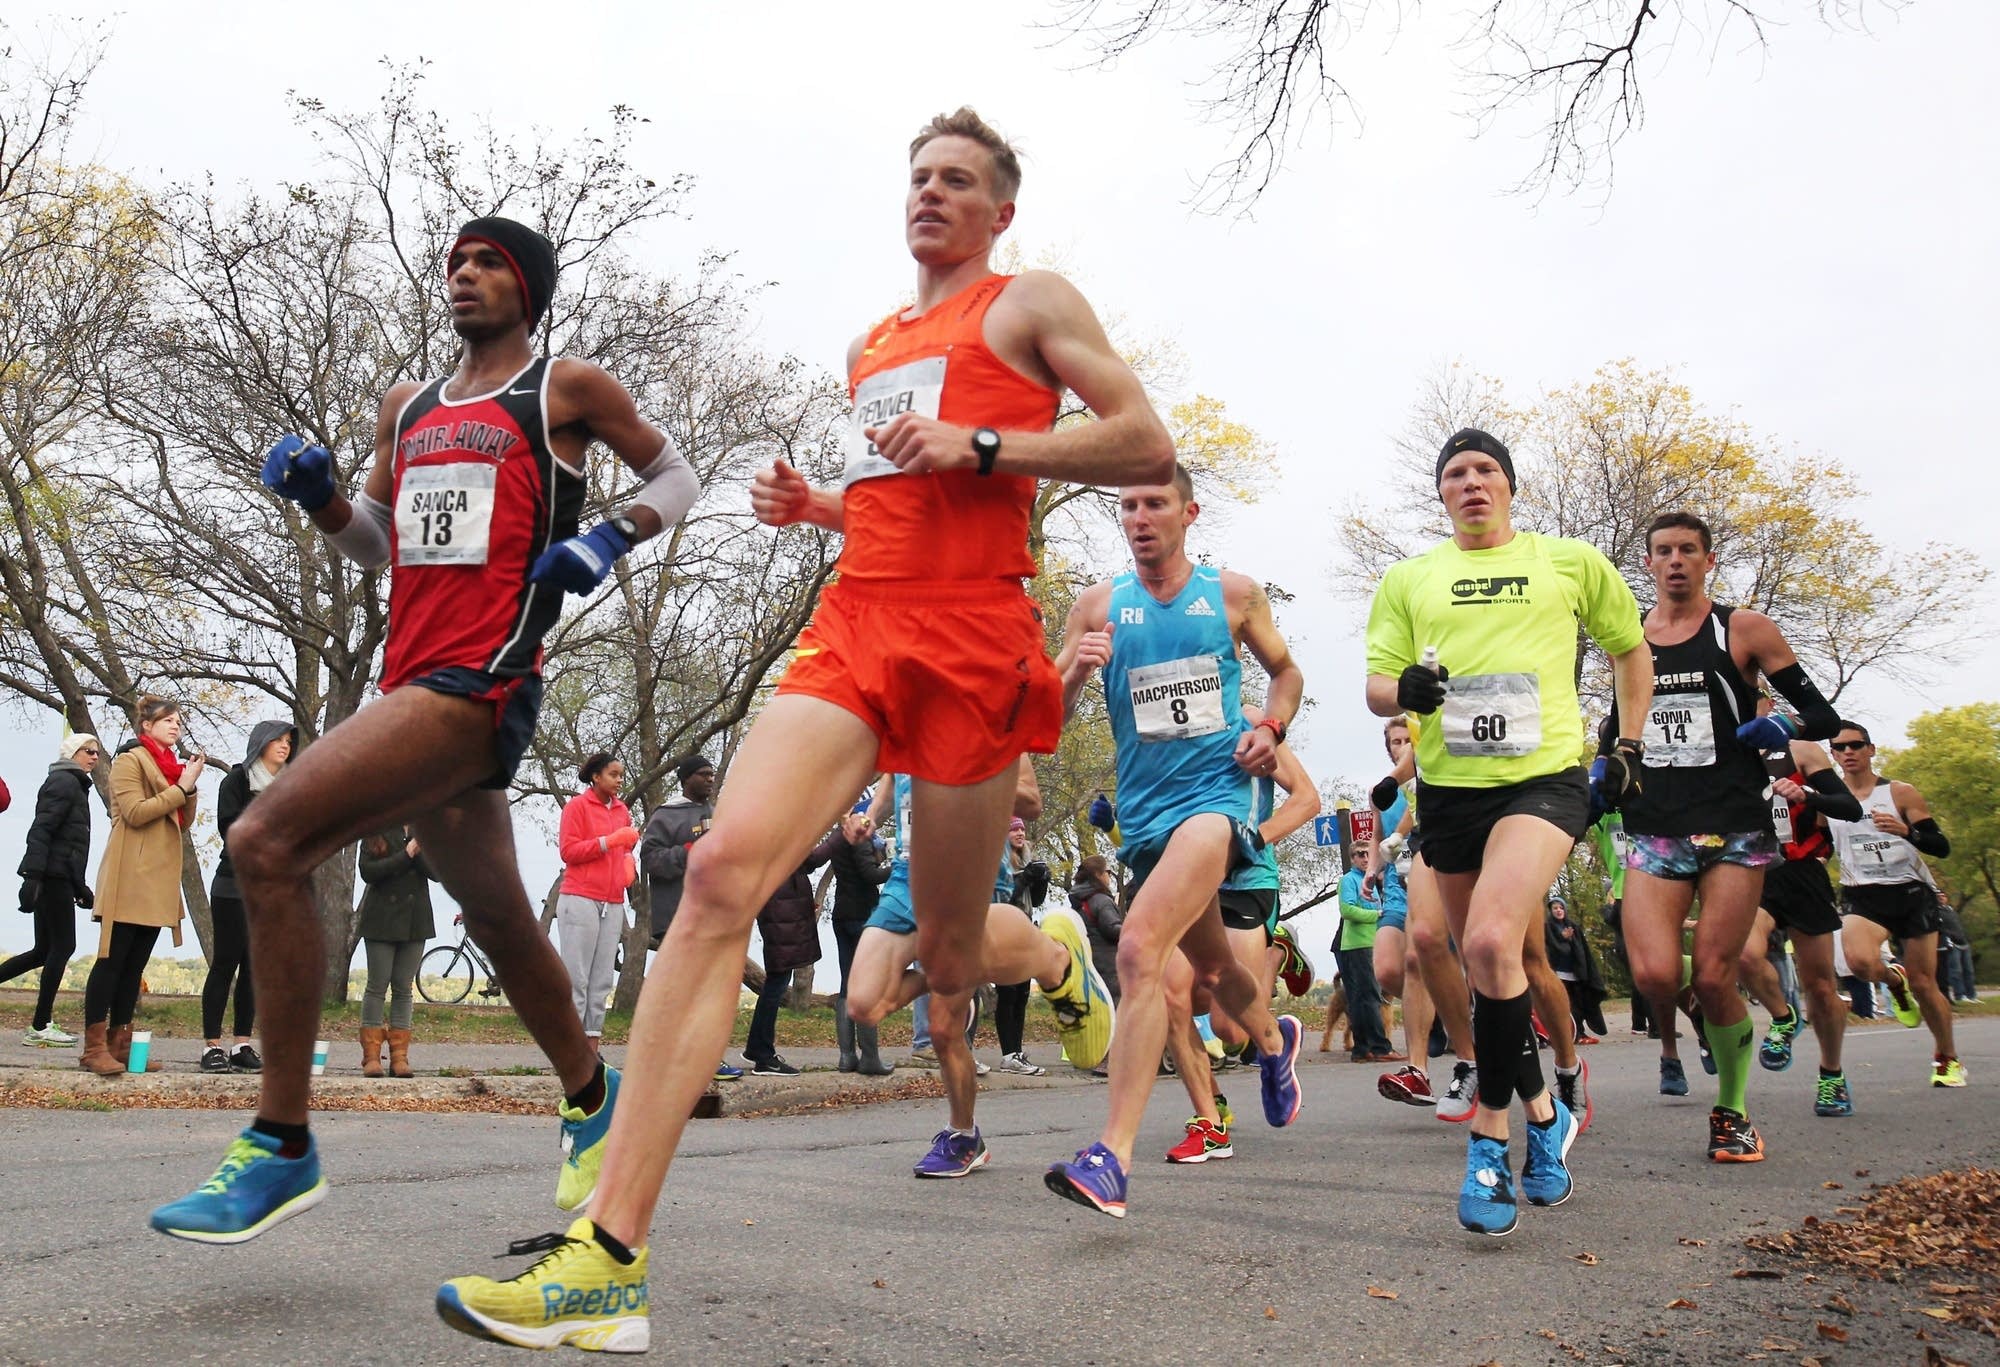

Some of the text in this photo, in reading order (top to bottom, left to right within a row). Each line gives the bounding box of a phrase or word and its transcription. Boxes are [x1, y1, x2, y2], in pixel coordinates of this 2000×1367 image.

[400, 420, 520, 463] WHIRLAWAY
[411, 490, 468, 513] SANCA
[421, 512, 453, 546] 13
[1452, 583, 1489, 592] INSIDE
[1184, 608, 1216, 617] adidas
[1132, 676, 1220, 706] MACPHERSON
[1170, 698, 1189, 725] 8
[1652, 710, 1692, 725] GONIA
[1472, 714, 1507, 742] 60
[1660, 723, 1688, 744] 14
[1354, 811, 1374, 821] WRONG
[1358, 820, 1370, 829] WAY
[1863, 841, 1891, 852] REYES
[1875, 850, 1884, 862] 1
